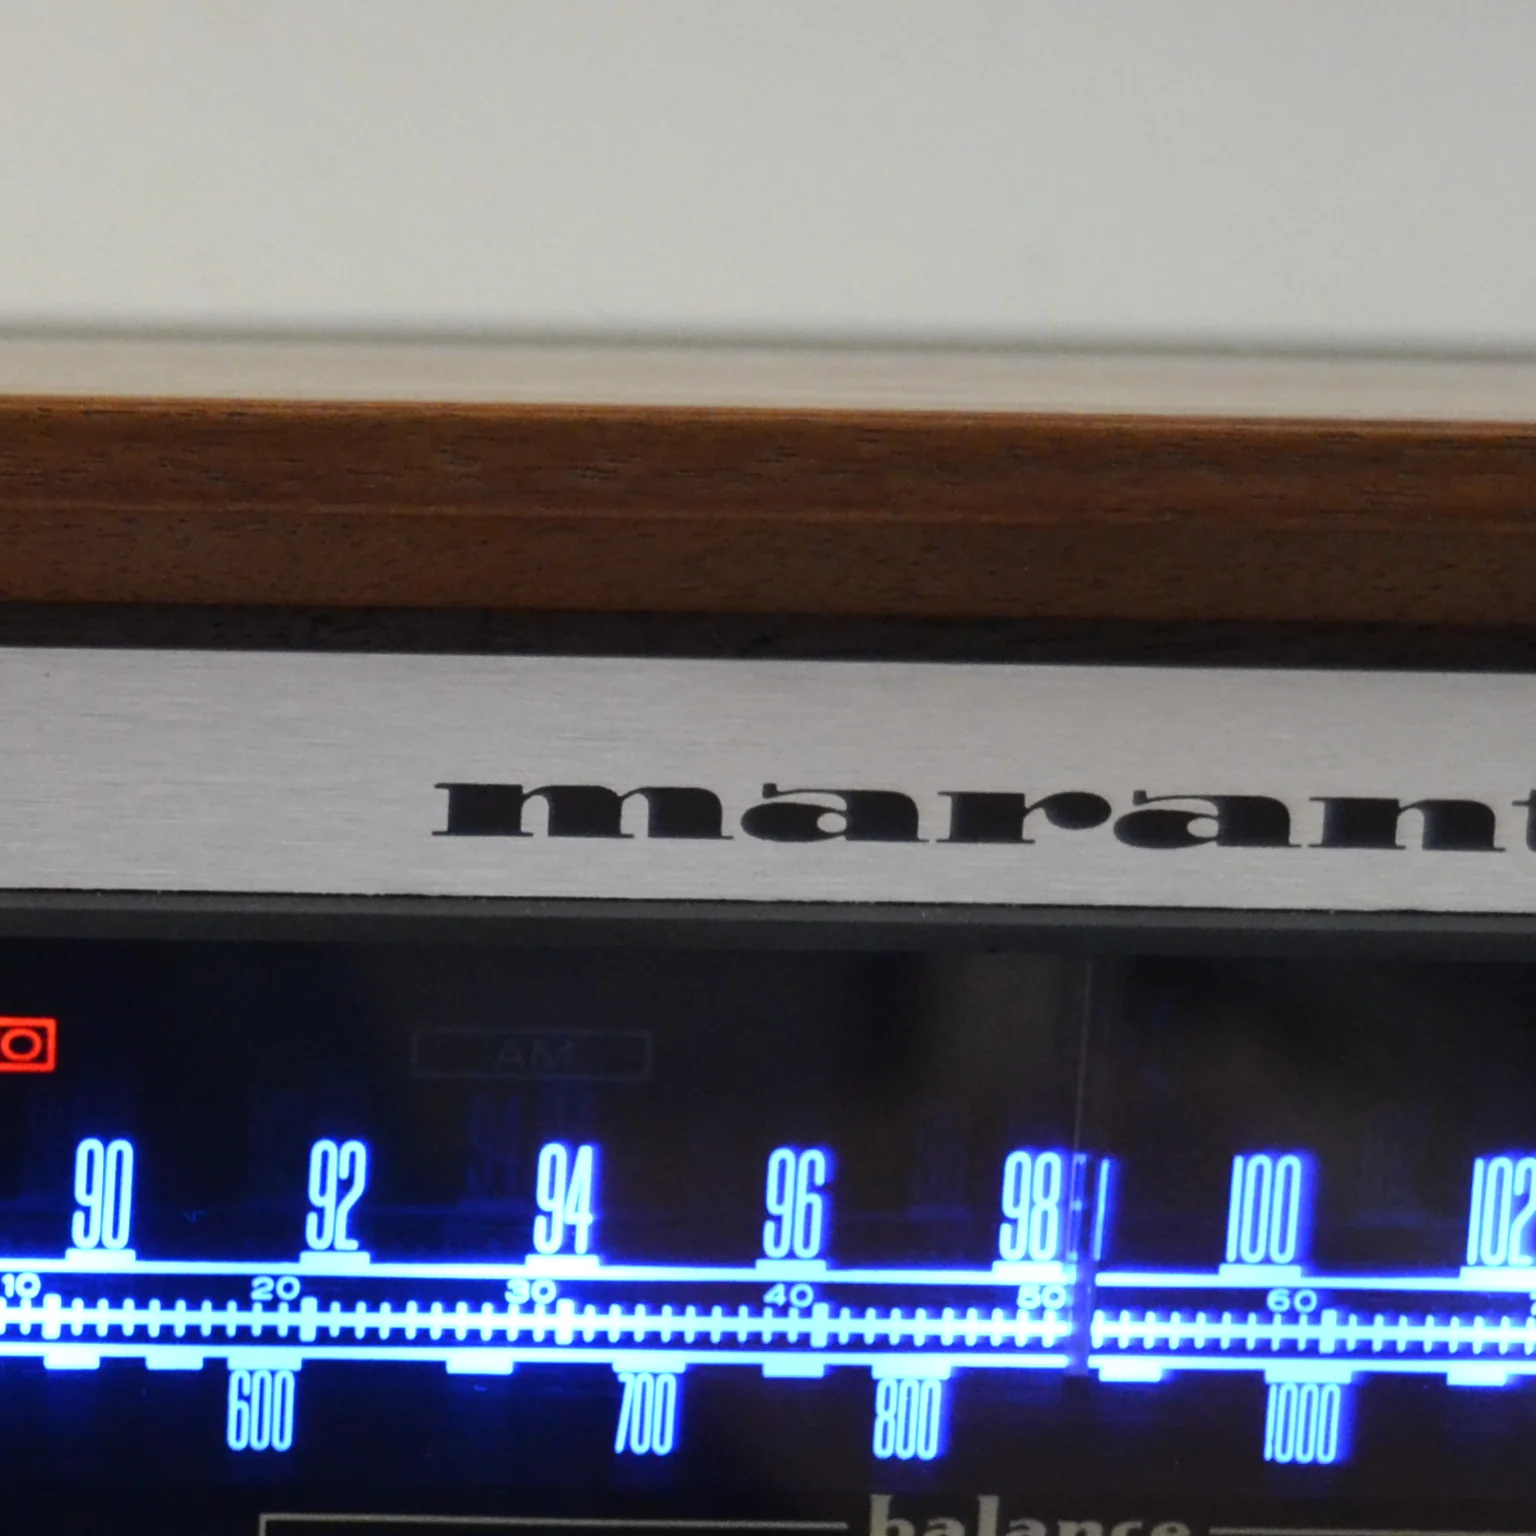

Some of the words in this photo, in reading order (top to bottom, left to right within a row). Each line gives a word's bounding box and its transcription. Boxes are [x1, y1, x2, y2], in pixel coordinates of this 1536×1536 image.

[431, 782, 1536, 853] maran
[71, 1138, 135, 1251] 90
[305, 1139, 368, 1254] 92
[532, 1142, 596, 1256] 94
[762, 1148, 827, 1259] 96
[998, 1150, 1062, 1262] 98
[1225, 1154, 1303, 1265] 100
[1466, 1156, 1536, 1267] 102
[1, 1272, 42, 1299] 10
[250, 1275, 301, 1301] 20
[504, 1278, 558, 1306] 30
[762, 1284, 815, 1310] 40
[1016, 1283, 1067, 1310] 50
[1266, 1289, 1318, 1314] 60
[226, 1369, 295, 1452] 600
[613, 1373, 677, 1455] 700
[872, 1377, 942, 1460] 800
[1263, 1382, 1340, 1465] 1000
